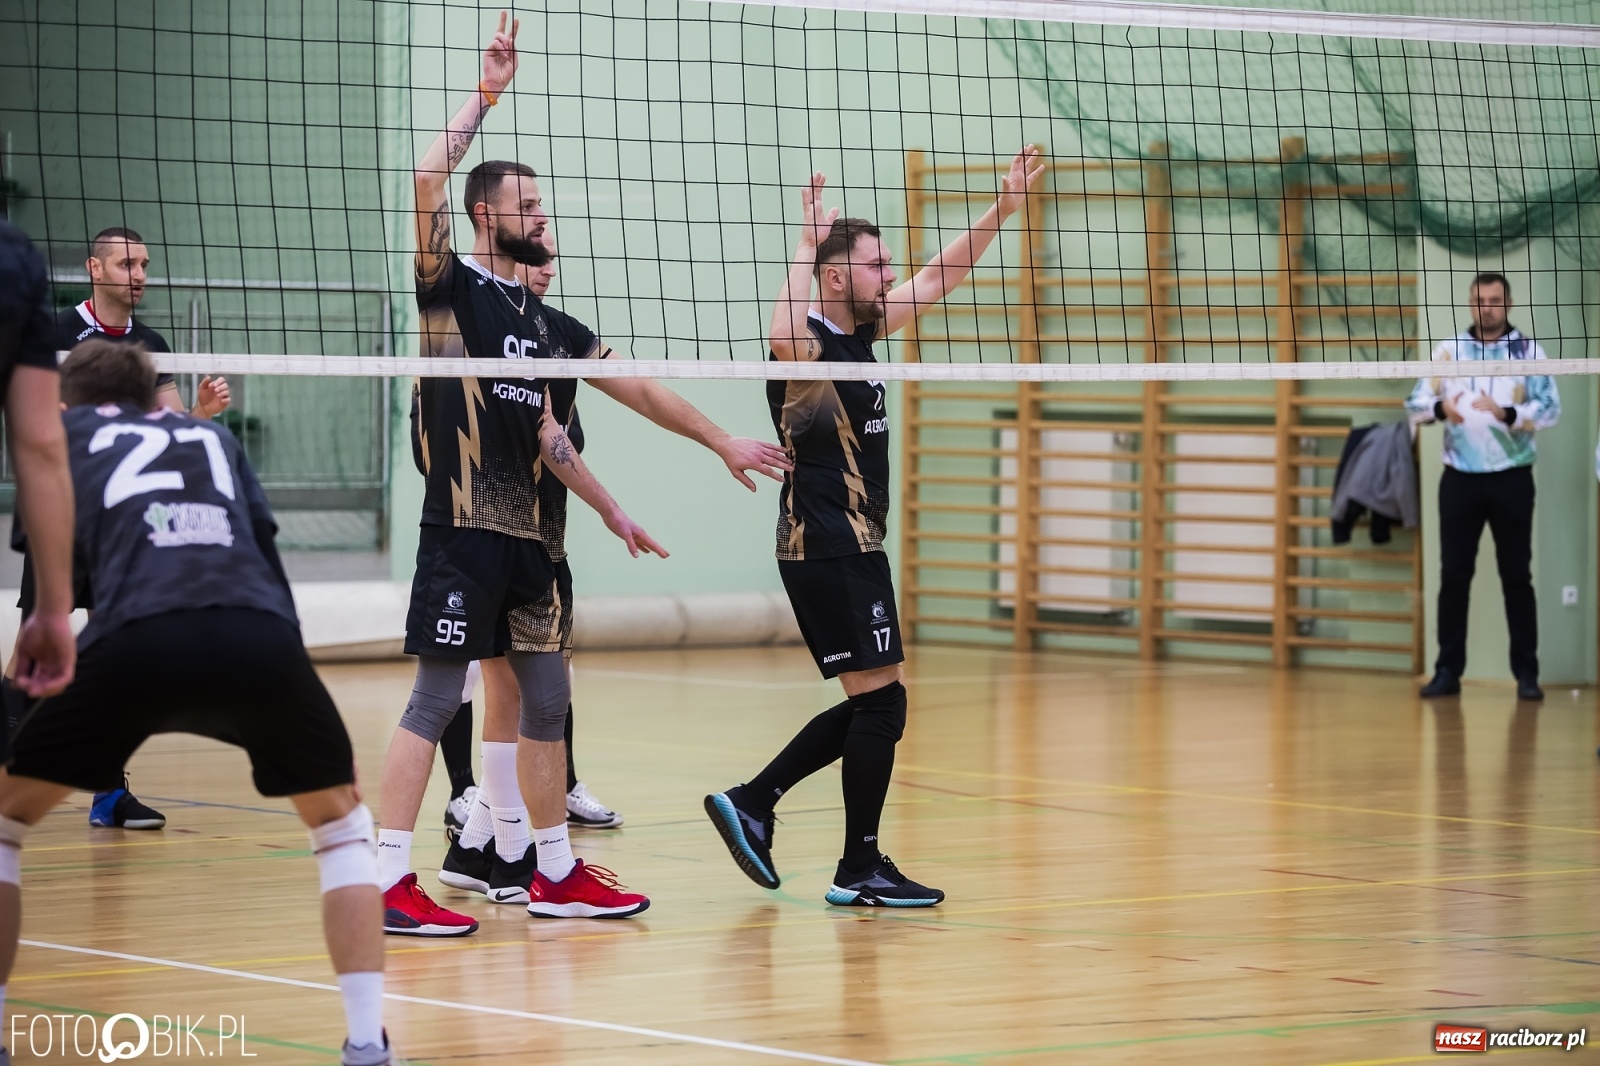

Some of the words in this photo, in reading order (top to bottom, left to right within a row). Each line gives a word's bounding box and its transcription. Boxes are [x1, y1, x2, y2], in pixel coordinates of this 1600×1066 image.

[492, 382, 542, 408] AGROTIM
[435, 618, 467, 646] 95
[872, 626, 891, 653] 17
[823, 651, 852, 664] AGROTIM
